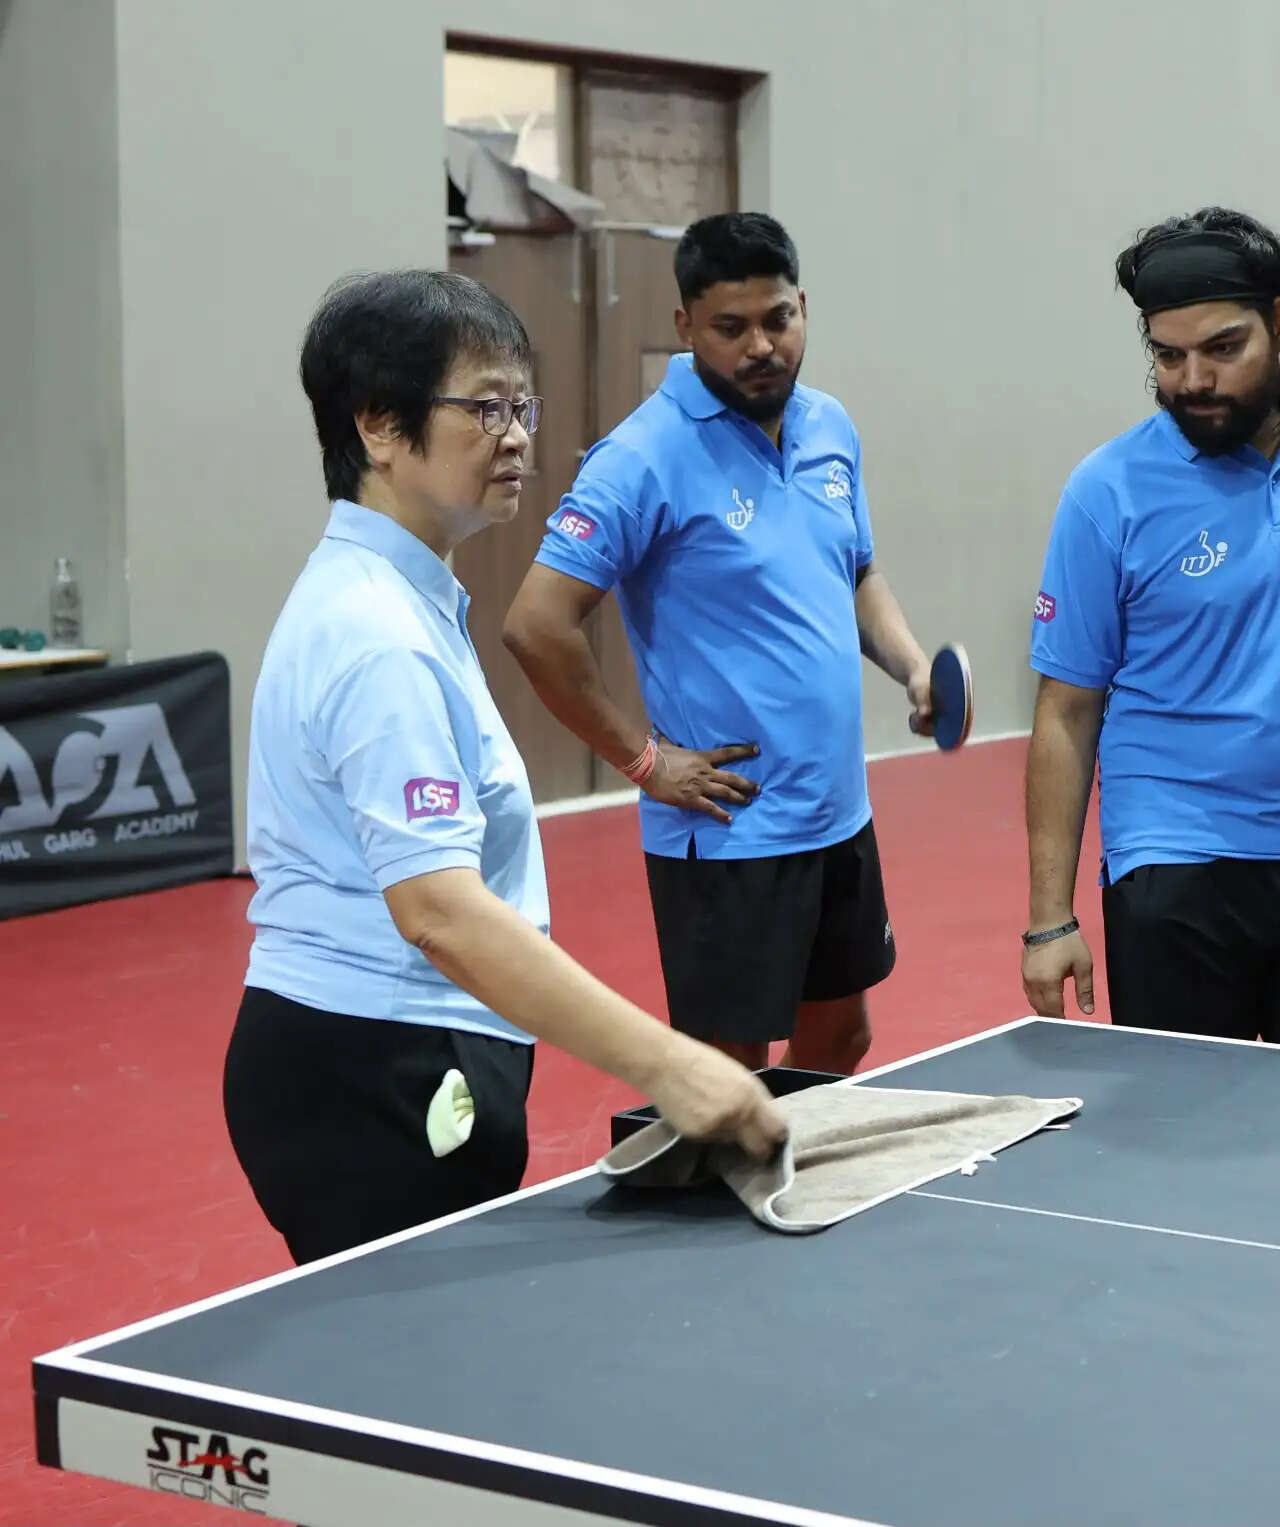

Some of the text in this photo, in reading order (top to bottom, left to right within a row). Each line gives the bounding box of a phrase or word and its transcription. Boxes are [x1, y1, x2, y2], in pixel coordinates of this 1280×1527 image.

[559, 515, 590, 536] ISF
[1180, 553, 1226, 571] ITTF
[1034, 595, 1053, 616] SF
[413, 783, 454, 812] ISF
[44, 828, 98, 854] GARG
[114, 810, 199, 844] ACADEMY
[146, 1426, 269, 1485] STAG
[149, 1468, 267, 1516] ICONIC
